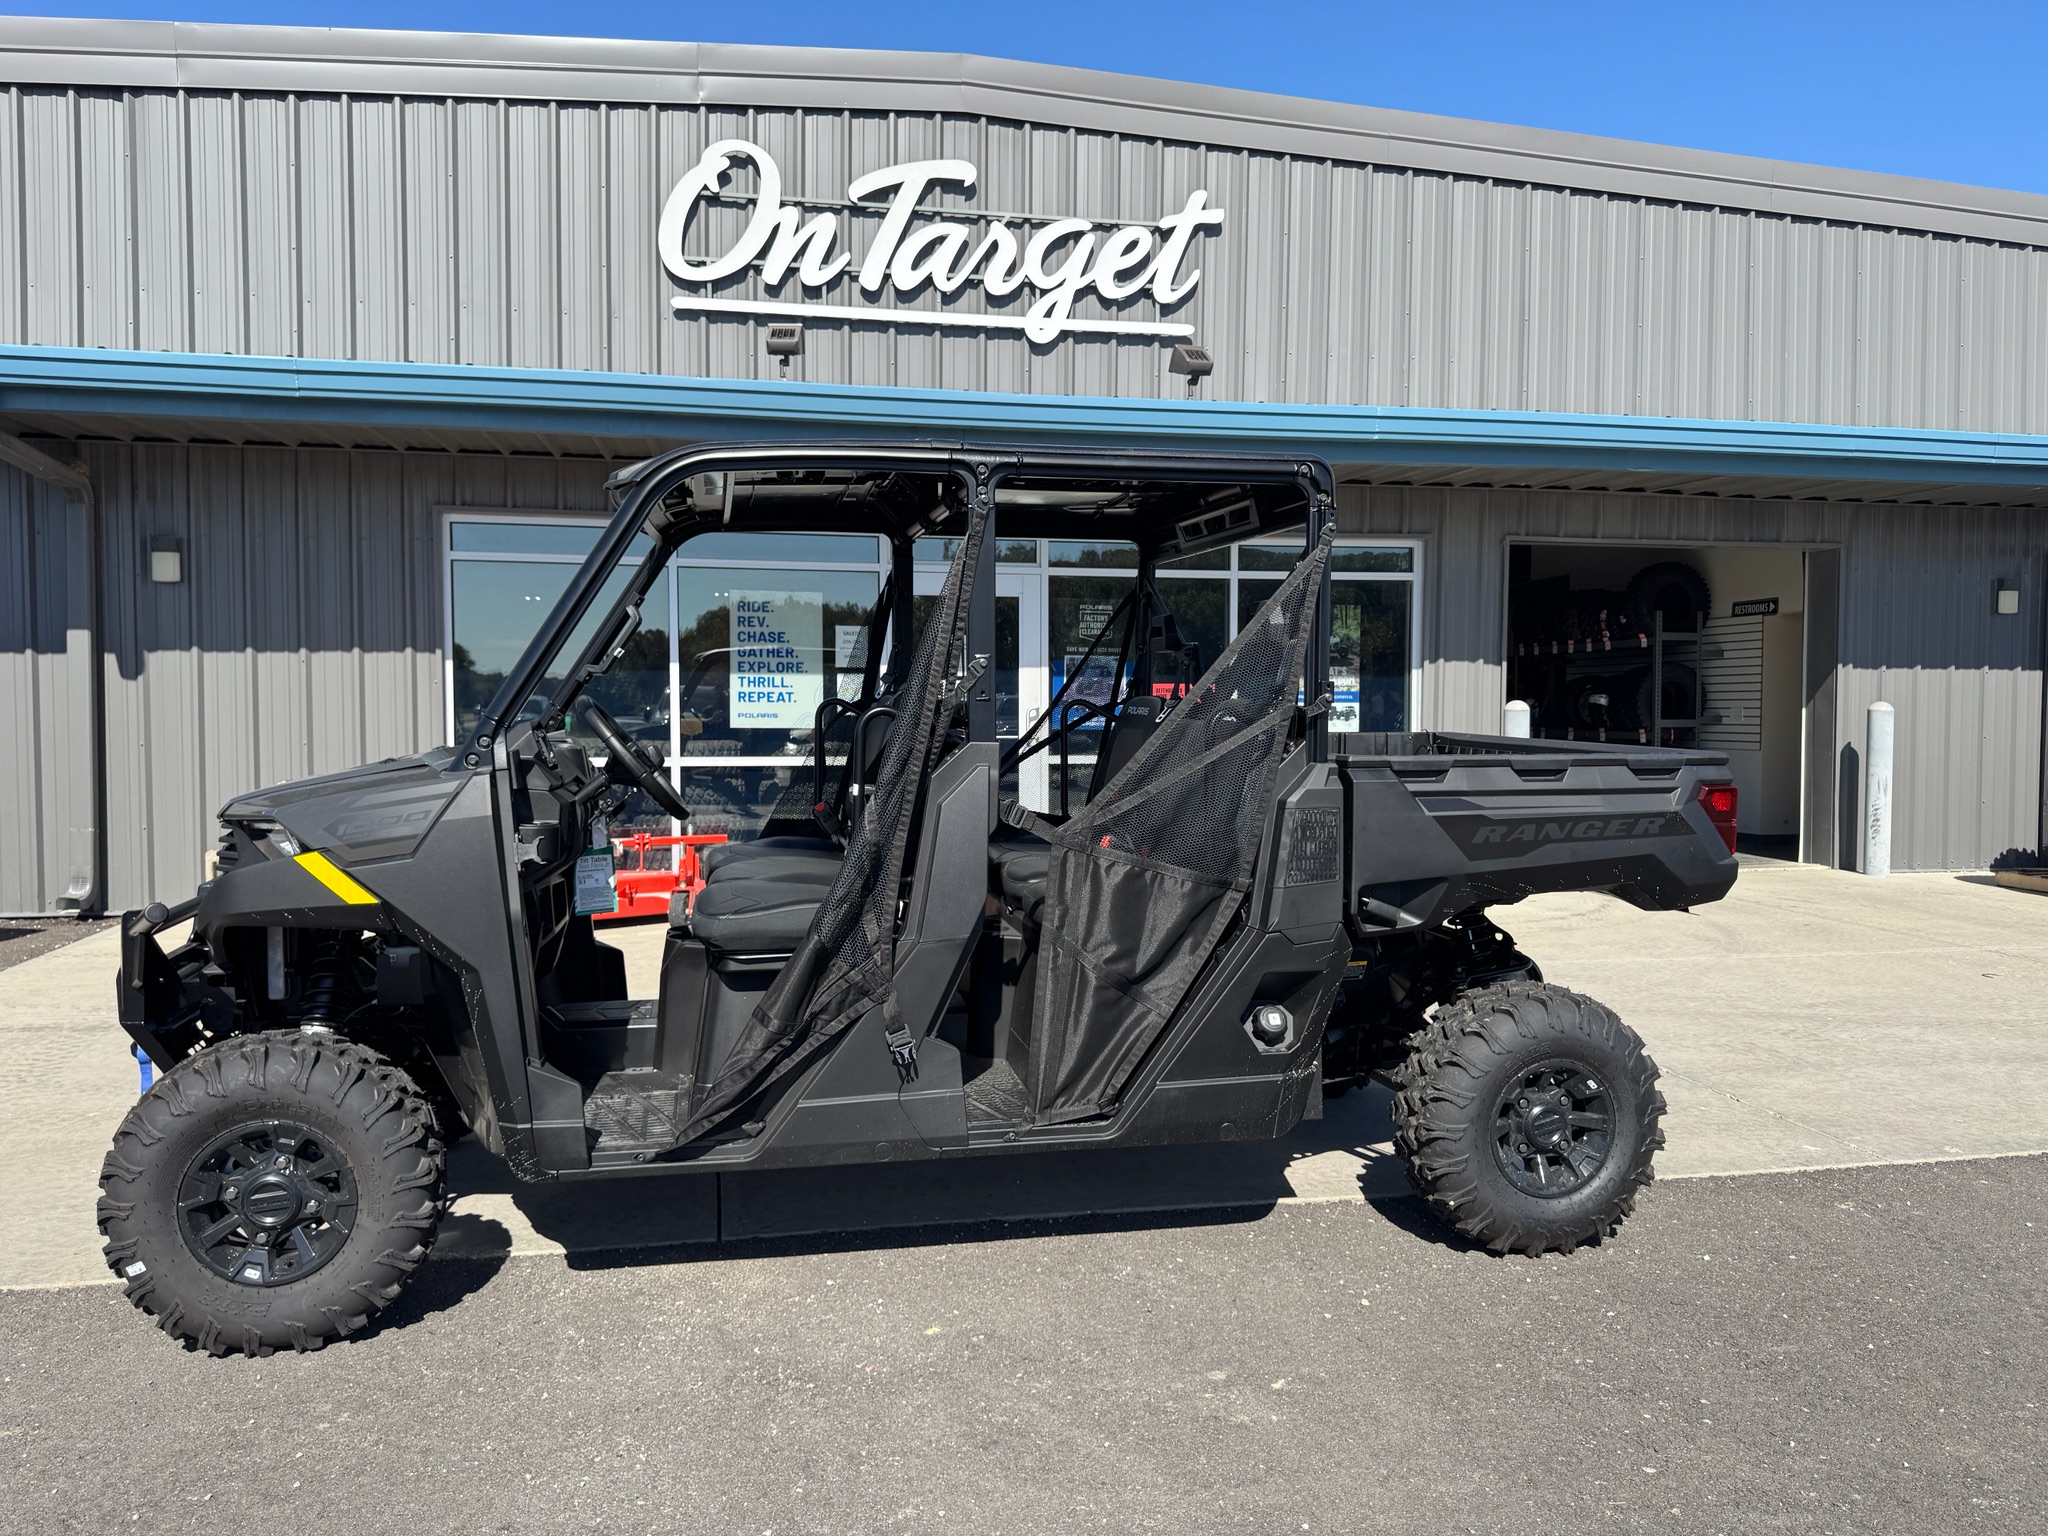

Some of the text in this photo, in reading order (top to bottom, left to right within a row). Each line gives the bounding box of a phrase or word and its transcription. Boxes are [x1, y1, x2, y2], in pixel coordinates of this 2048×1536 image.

[737, 601, 774, 613] RIDE.
[1734, 603, 1769, 615] RESTROOMS
[737, 616, 769, 628] REV.
[737, 631, 790, 643] CHASE.
[737, 646, 798, 658] GATHER.
[738, 661, 808, 673] EXPLORE.
[1329, 666, 1347, 676] AT'S
[738, 676, 793, 688] THRILL.
[738, 691, 797, 703] REPEAT.
[1127, 706, 1150, 715] POLARIS
[1471, 817, 1666, 844] RANGER
